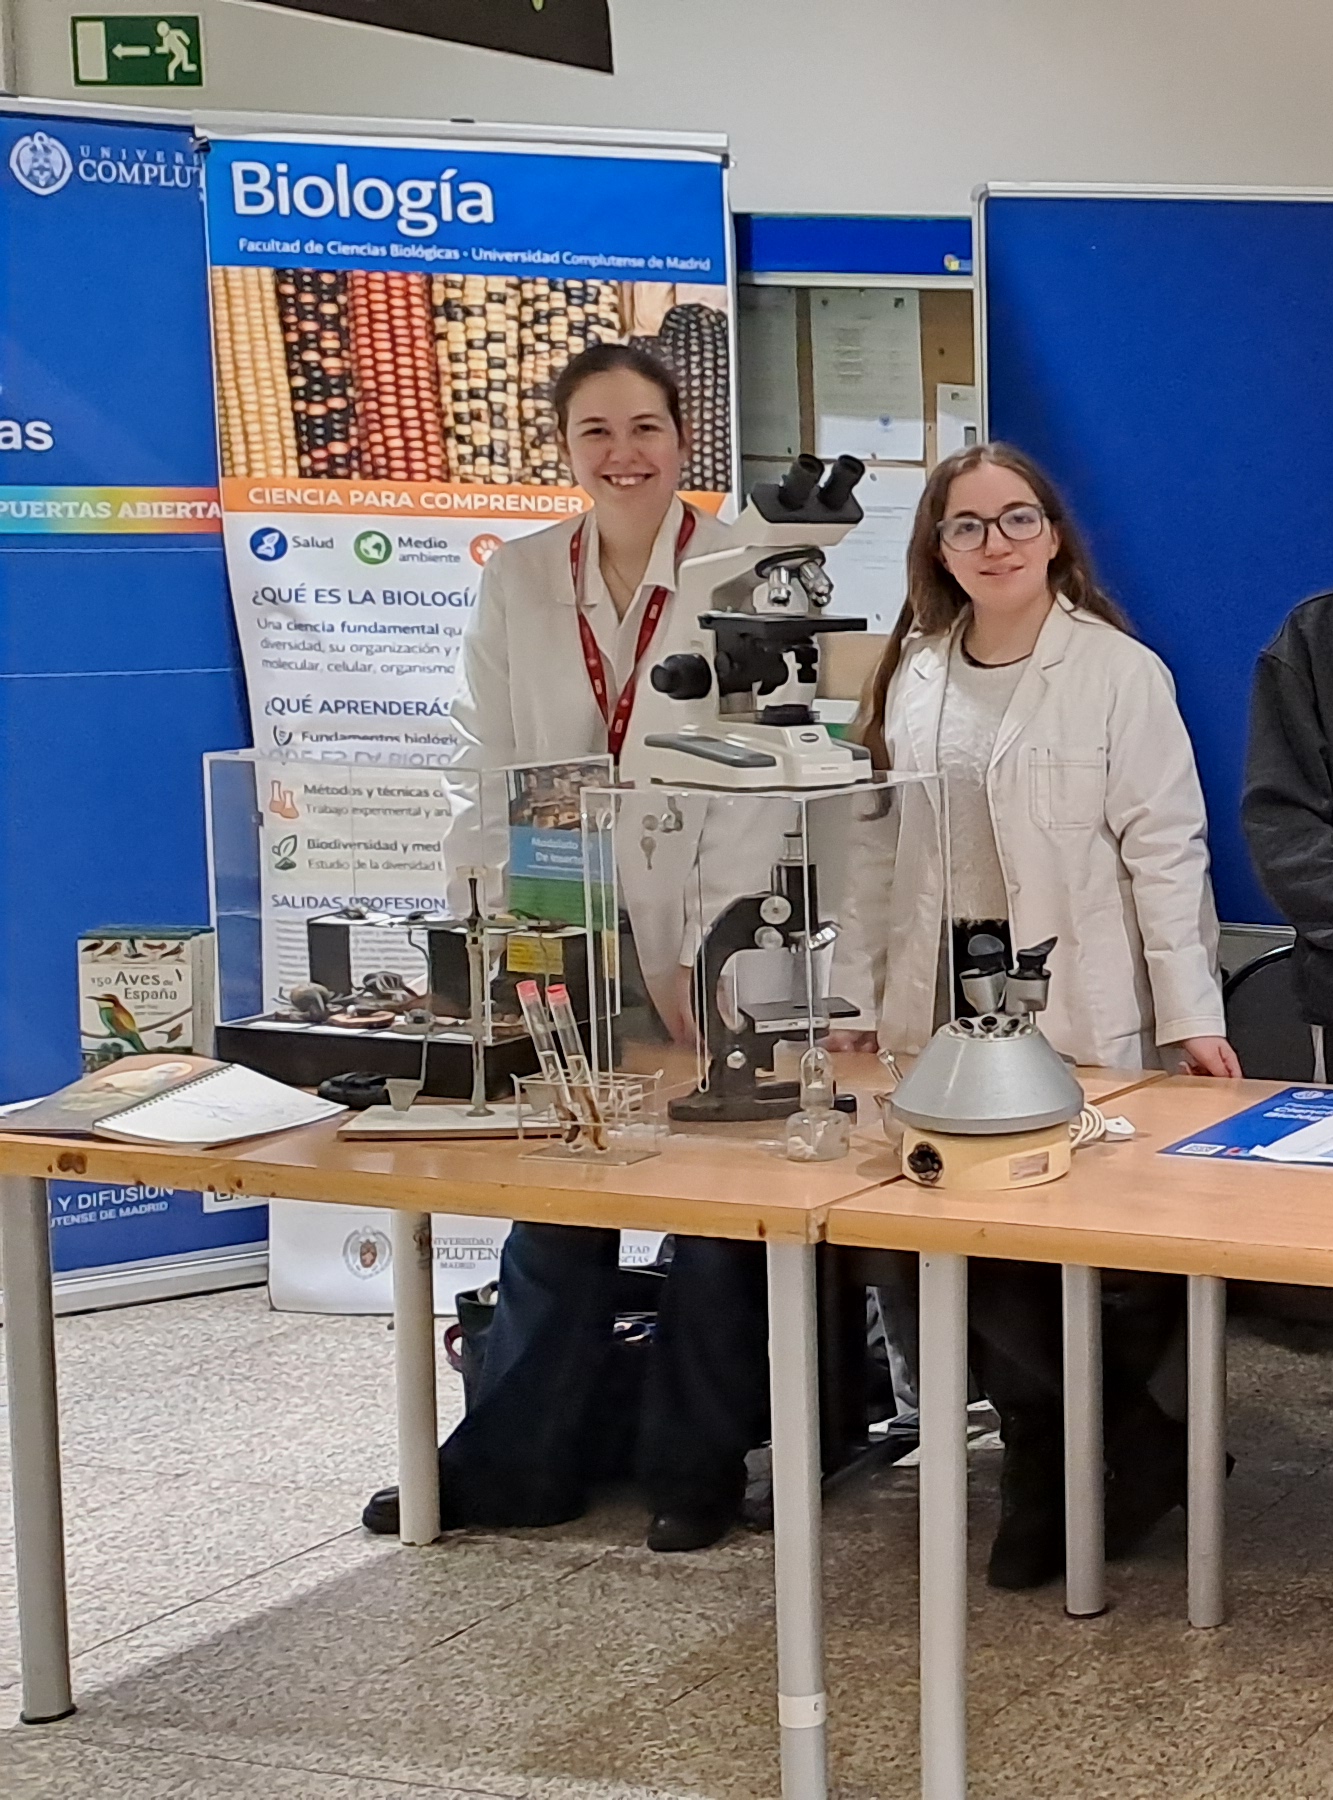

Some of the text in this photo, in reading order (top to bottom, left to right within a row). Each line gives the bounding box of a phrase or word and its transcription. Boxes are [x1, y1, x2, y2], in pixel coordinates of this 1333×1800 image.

[230, 159, 496, 238] Biología
[238, 237, 711, 271] Facultad de Ciencias Biológicas Universidad Complutense de Madrid
[248, 486, 585, 514] CIENCIA PARA COMPRENDER
[291, 535, 449, 551] Salud Medio
[397, 550, 462, 565] ambiente
[251, 582, 307, 606] ¿QUÉ
[313, 587, 342, 605] ES
[347, 588, 376, 605] LA
[264, 693, 313, 716] ¿QUÉ
[114, 970, 161, 987] Aves
[123, 986, 178, 1003] España
[99, 1200, 169, 1222] DE MADRID
